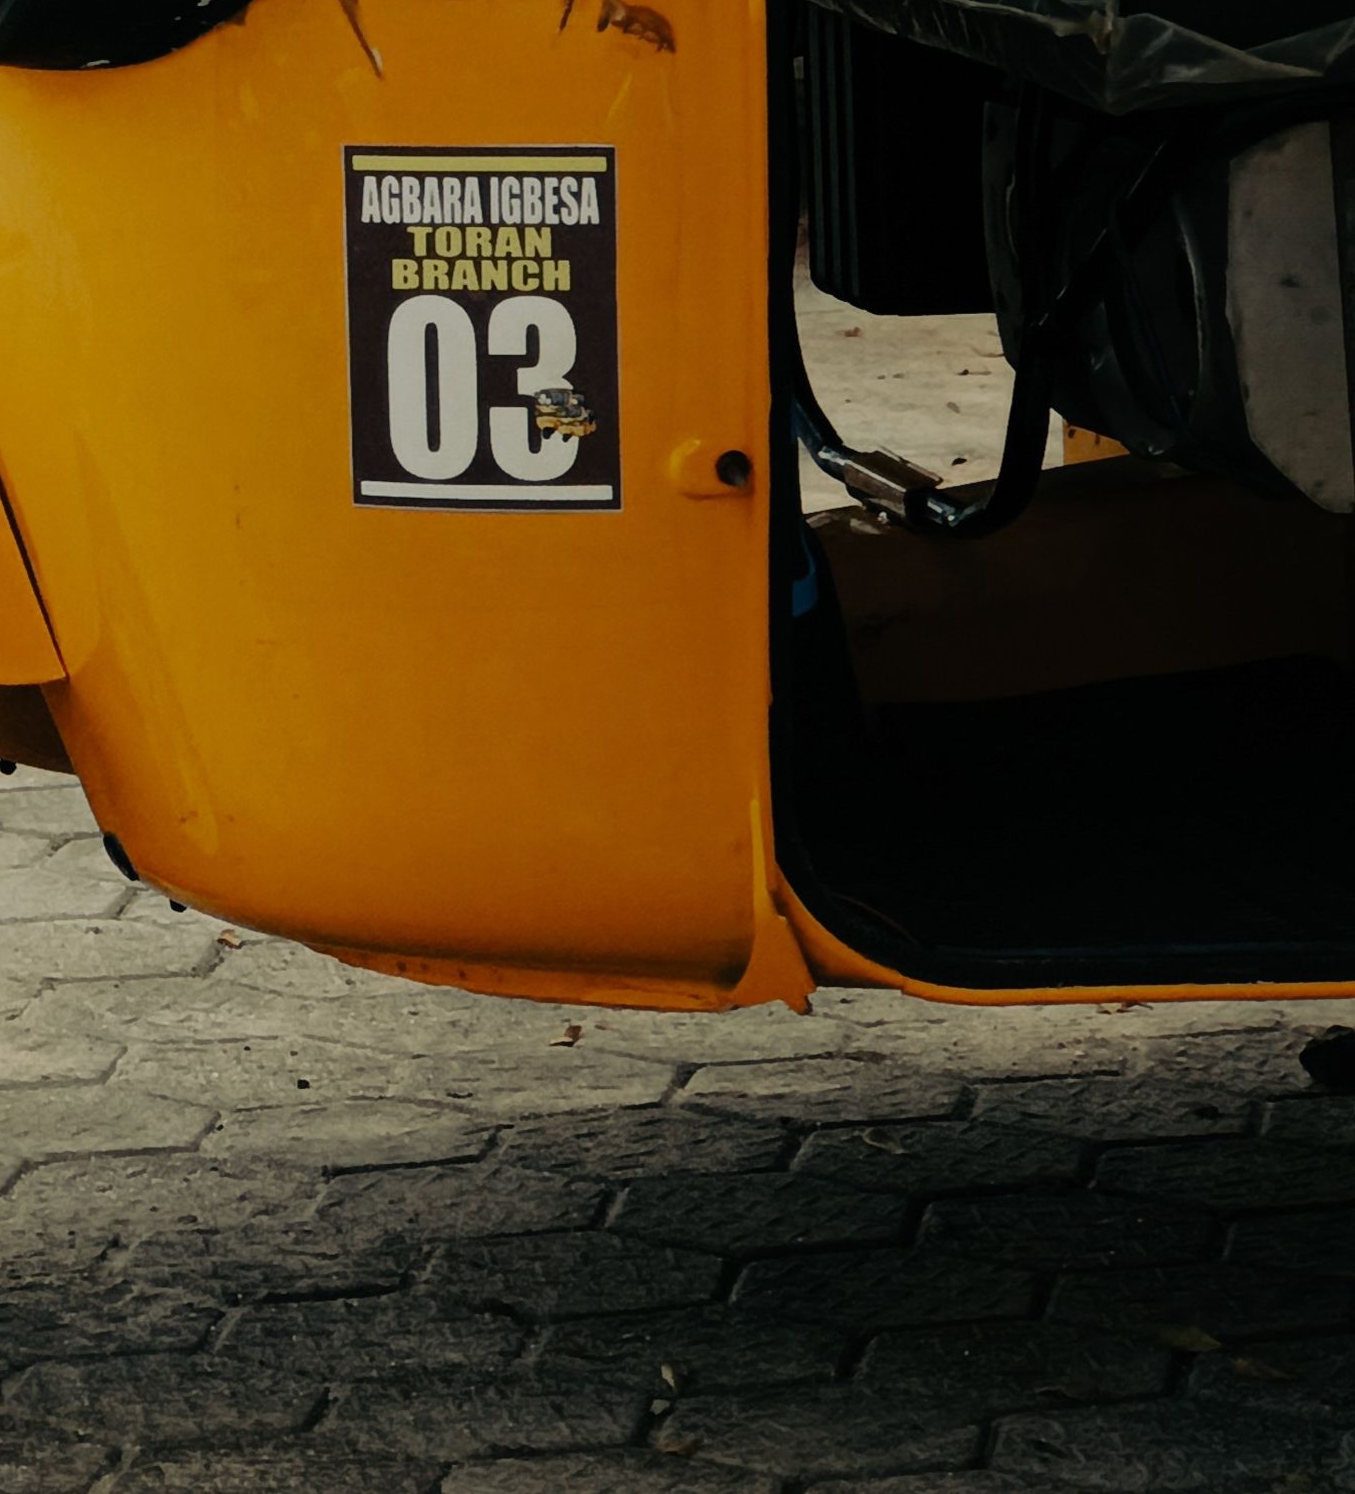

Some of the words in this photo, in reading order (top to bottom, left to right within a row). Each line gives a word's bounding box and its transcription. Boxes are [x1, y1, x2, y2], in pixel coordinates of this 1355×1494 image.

[361, 176, 483, 224] AGBARA
[490, 177, 600, 225] IGBESA
[406, 226, 552, 259] TORAN
[391, 259, 571, 292] BRANCH
[387, 294, 580, 482] 03
